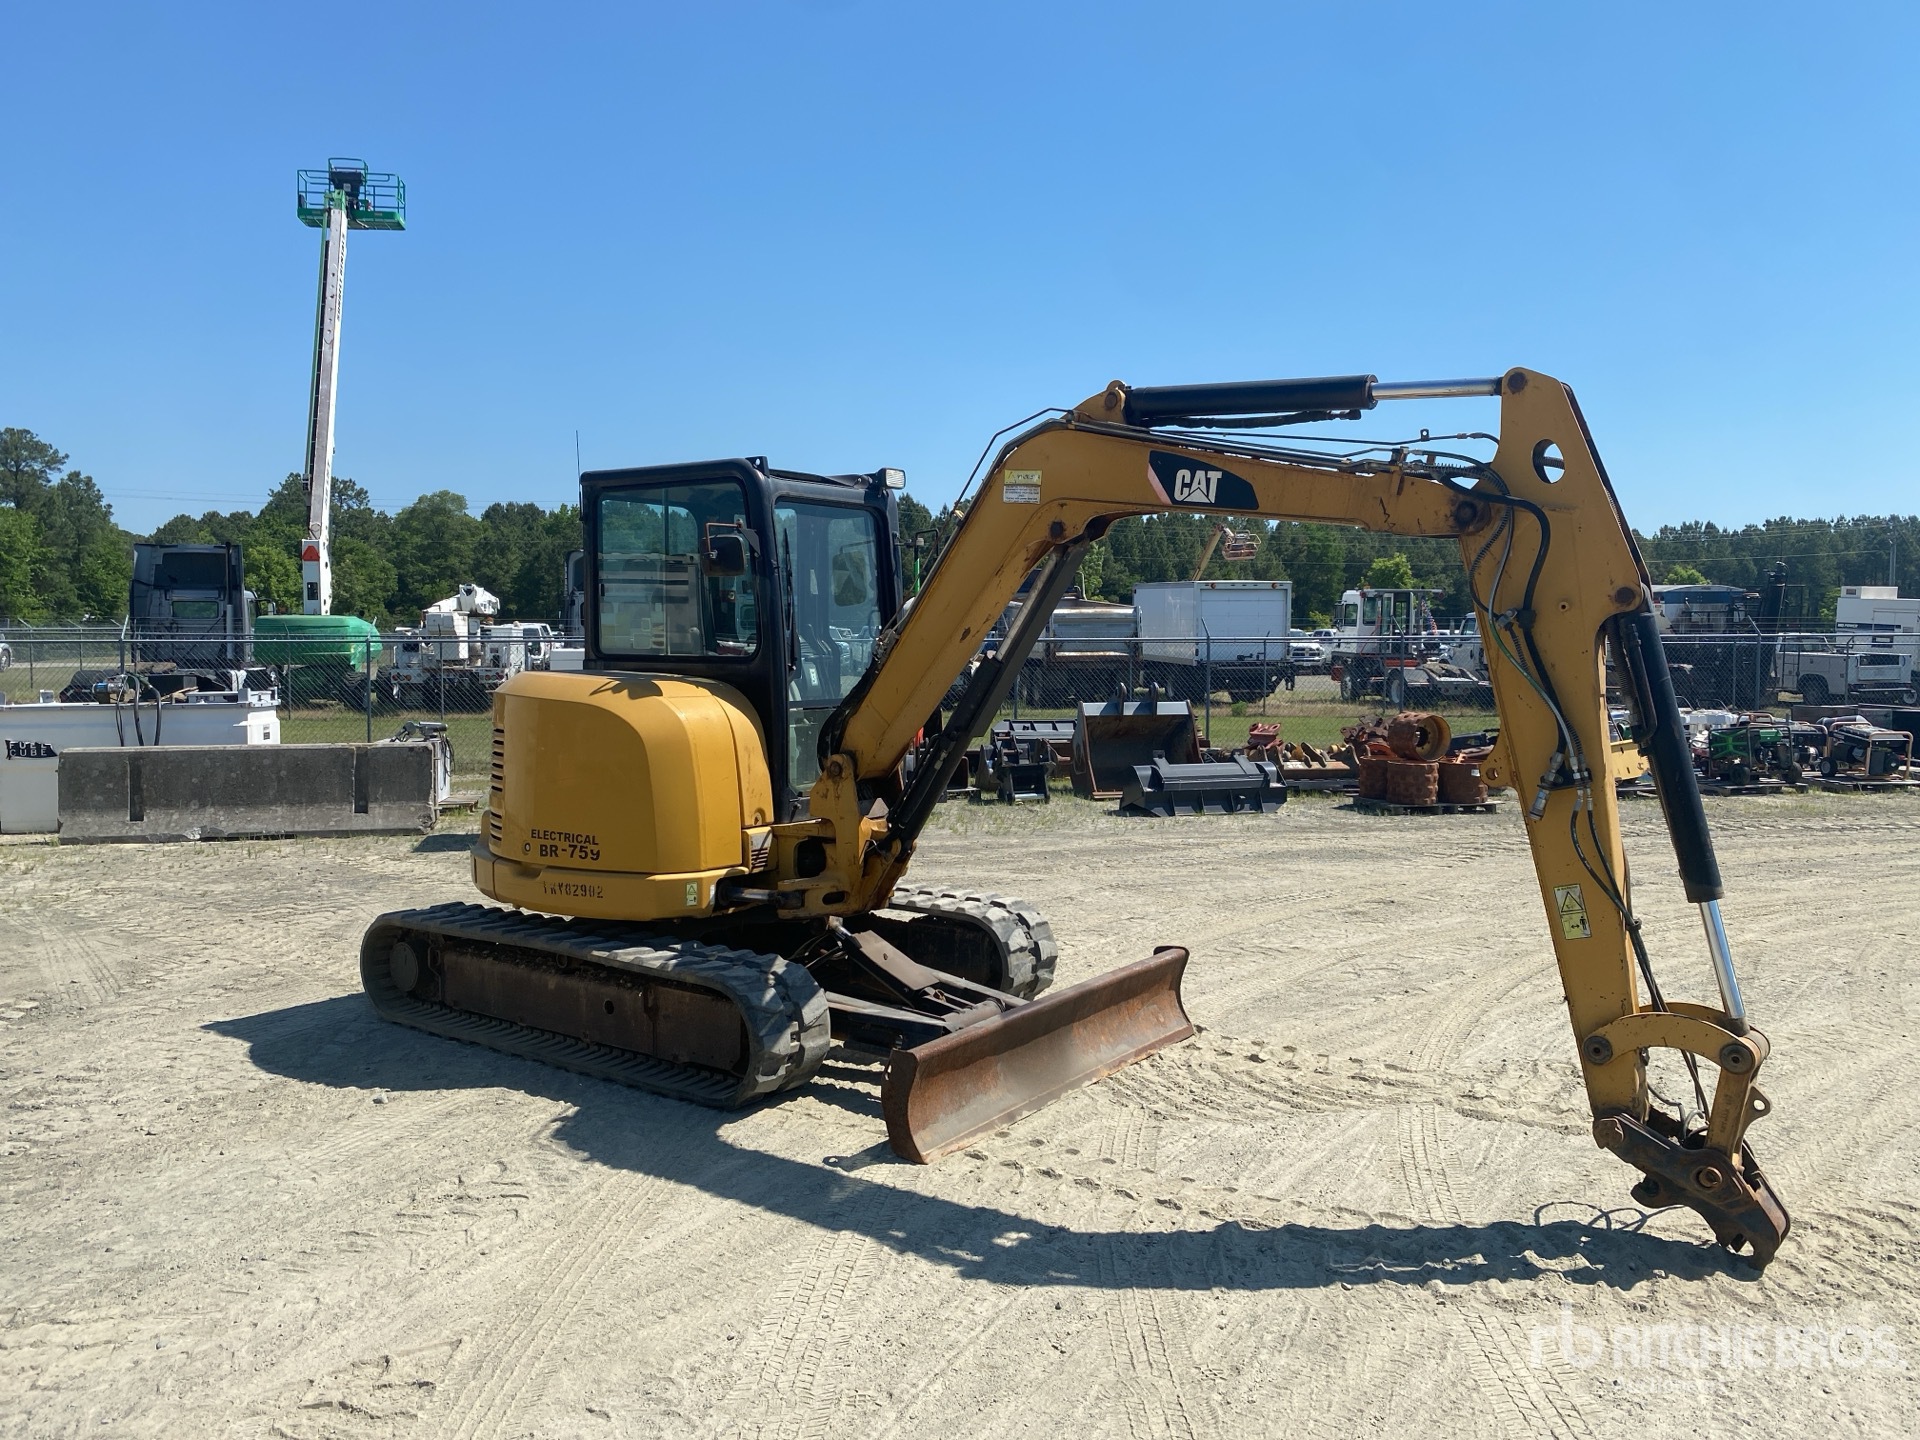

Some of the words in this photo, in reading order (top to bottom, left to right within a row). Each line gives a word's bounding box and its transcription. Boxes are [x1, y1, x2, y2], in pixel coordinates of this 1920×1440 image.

[1174, 469, 1222, 503] CAT
[10, 749, 47, 757] CUBE
[531, 829, 599, 846] ELECTRICAL
